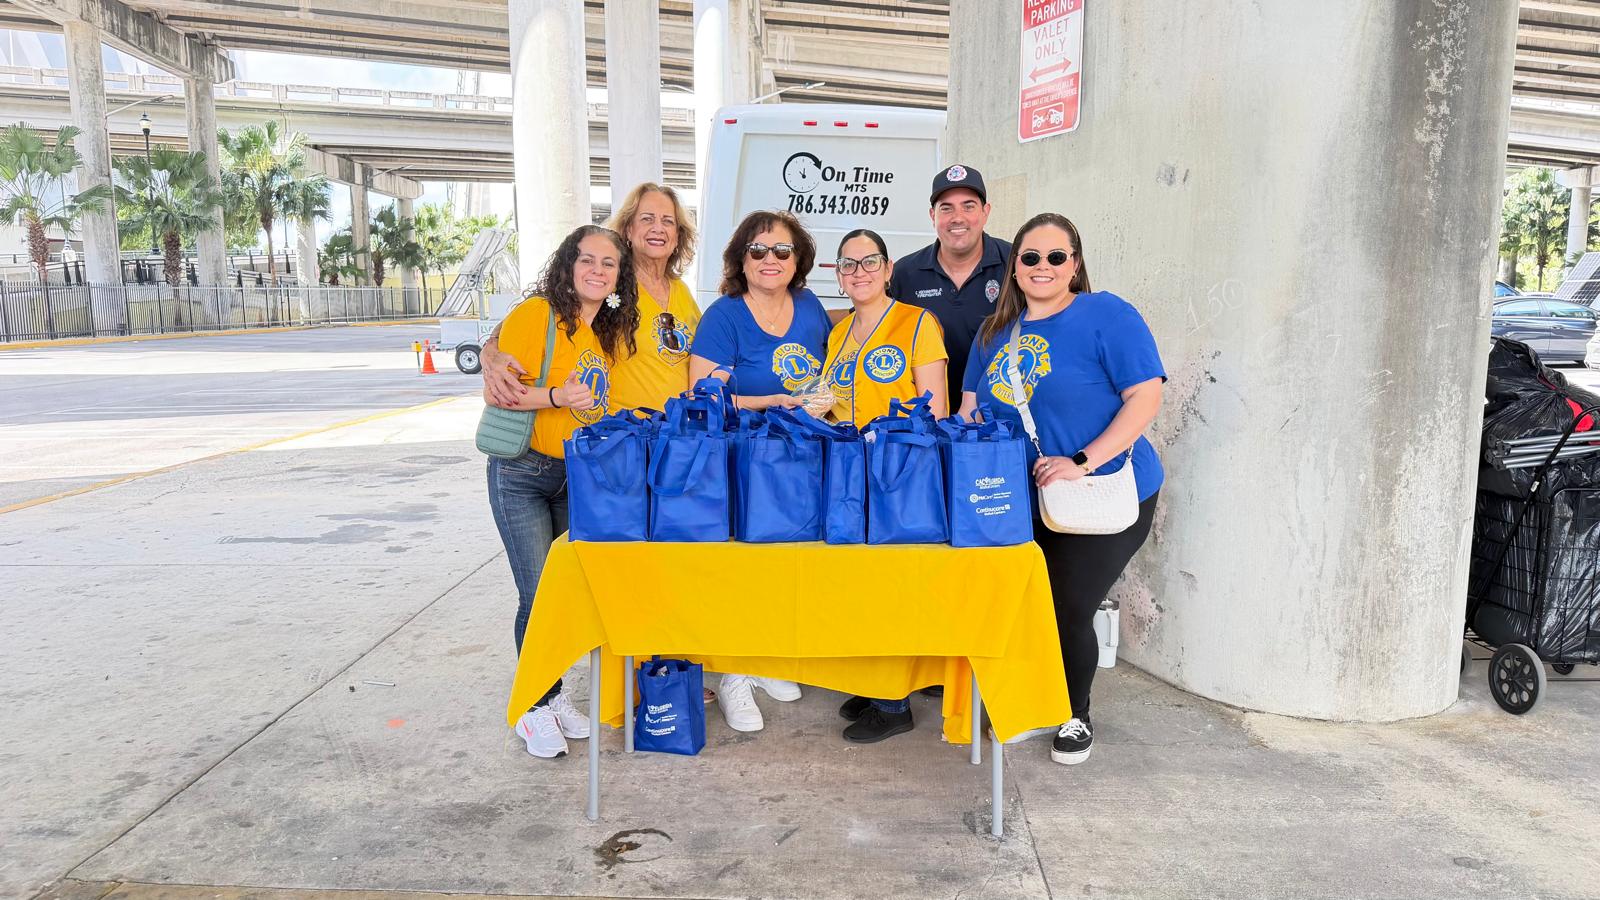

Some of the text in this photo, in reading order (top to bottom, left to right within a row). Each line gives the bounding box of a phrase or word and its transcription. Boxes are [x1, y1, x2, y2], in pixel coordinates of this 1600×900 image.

[1031, 0, 1074, 26] PARKING
[1033, 18, 1070, 43] VALET
[1035, 38, 1066, 60] ONLY
[821, 166, 894, 184] On Time
[844, 184, 867, 192] MTS
[788, 194, 889, 216] 786.343.0859
[776, 345, 804, 357] LIONS
[789, 358, 806, 375] L
[880, 356, 890, 368] L
[840, 363, 850, 380] L
[591, 373, 600, 400] L
